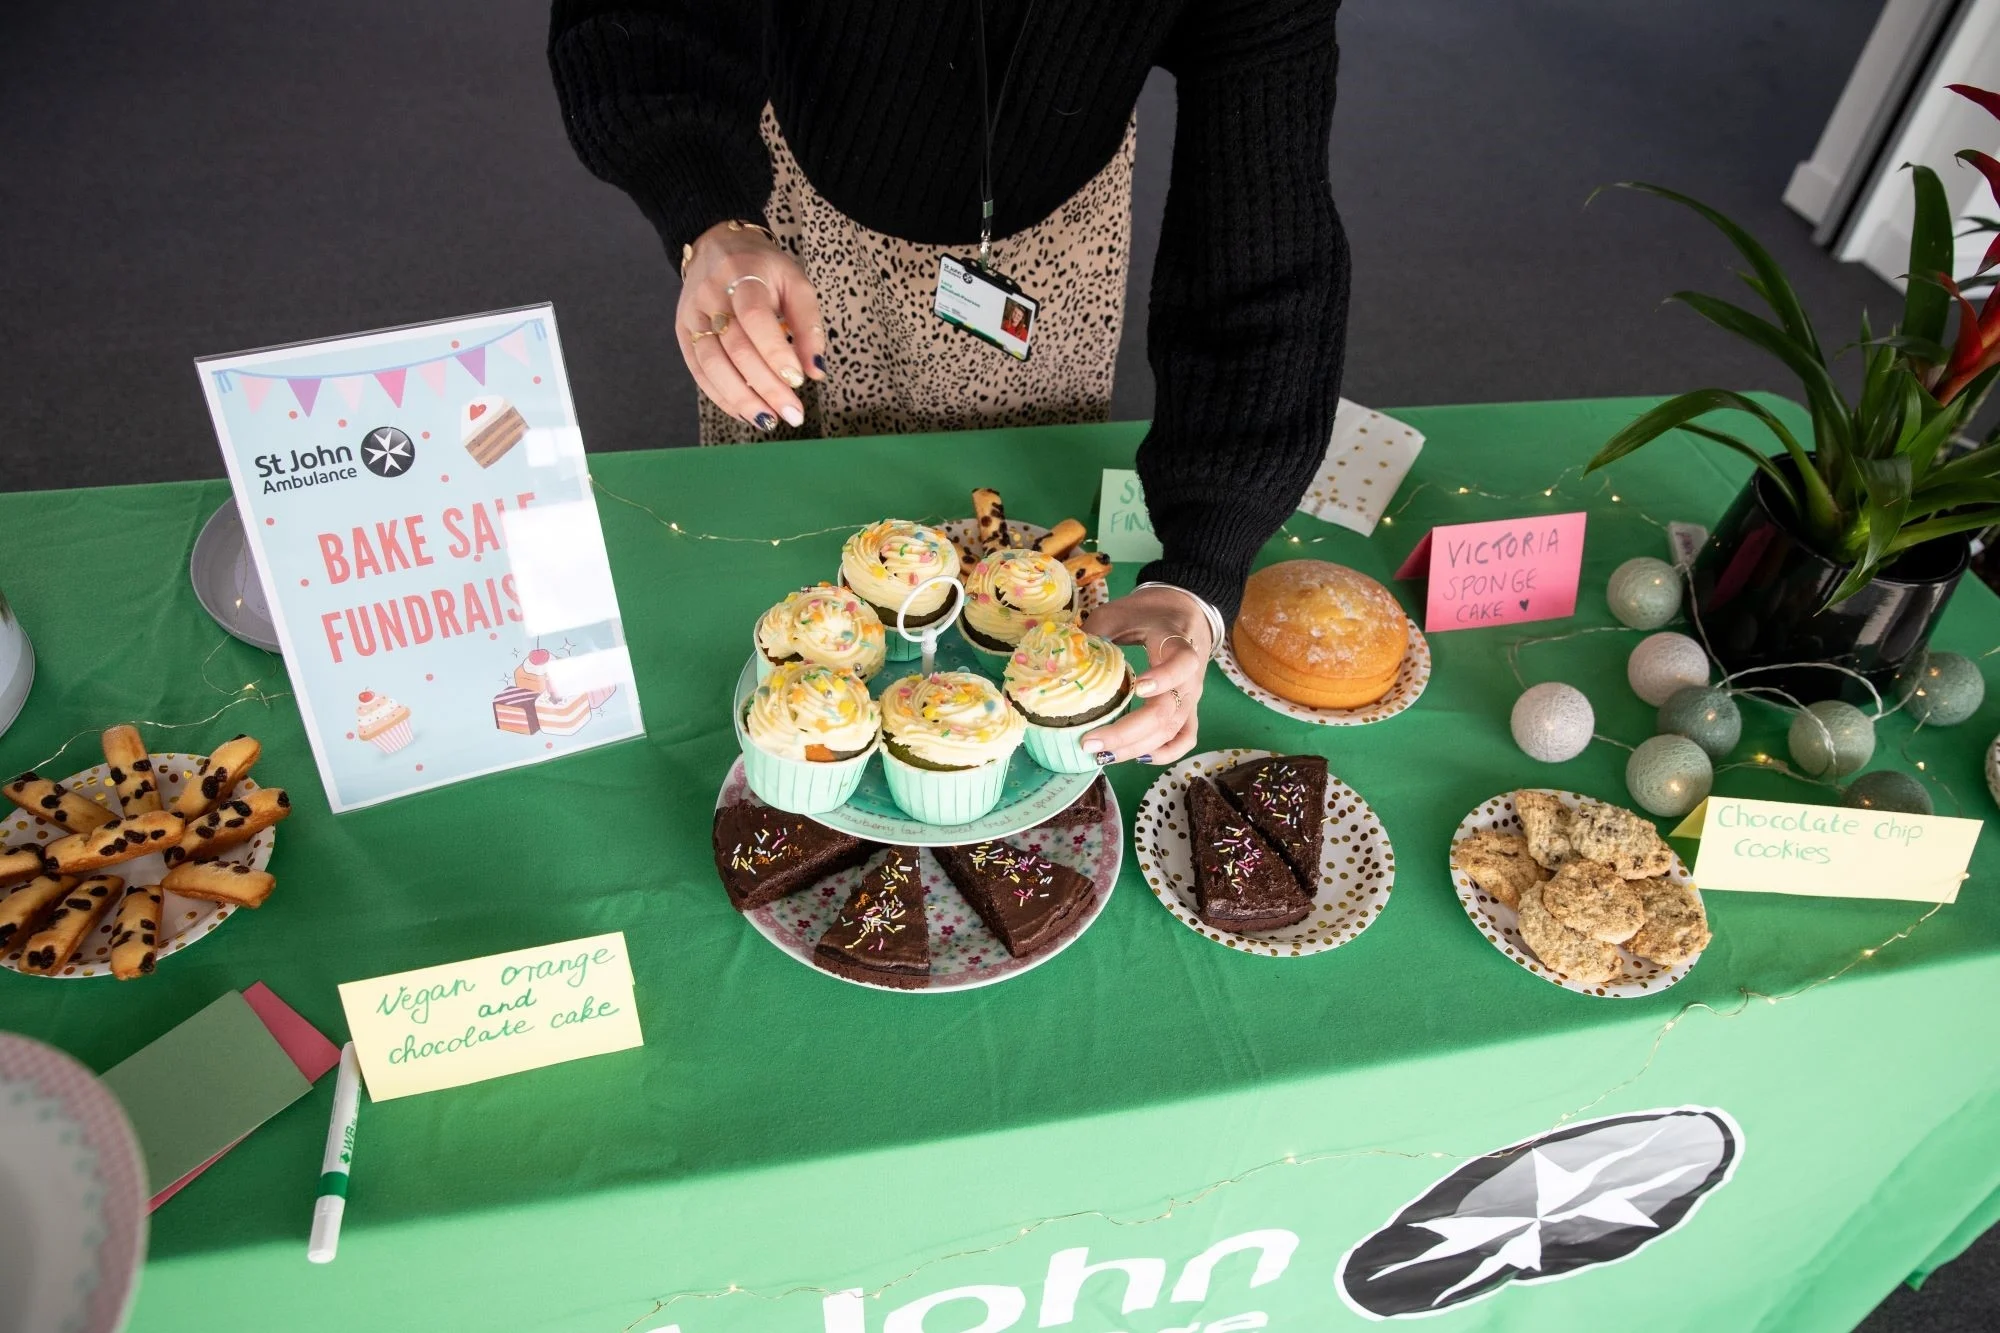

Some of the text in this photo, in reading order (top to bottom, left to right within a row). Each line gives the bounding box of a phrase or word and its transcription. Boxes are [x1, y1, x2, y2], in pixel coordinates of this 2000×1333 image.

[254, 442, 354, 479] St John
[263, 466, 358, 495] Ambulance
[318, 492, 536, 584] BAKE SA
[1447, 528, 1560, 569] VICTORIA
[1443, 568, 1538, 600] SPONGE
[1456, 600, 1504, 623] CAKE
[1717, 804, 1860, 836] Chocolate
[376, 976, 476, 1025] Vegan
[478, 987, 537, 1018] and
[388, 995, 621, 1065] chocolate cake
